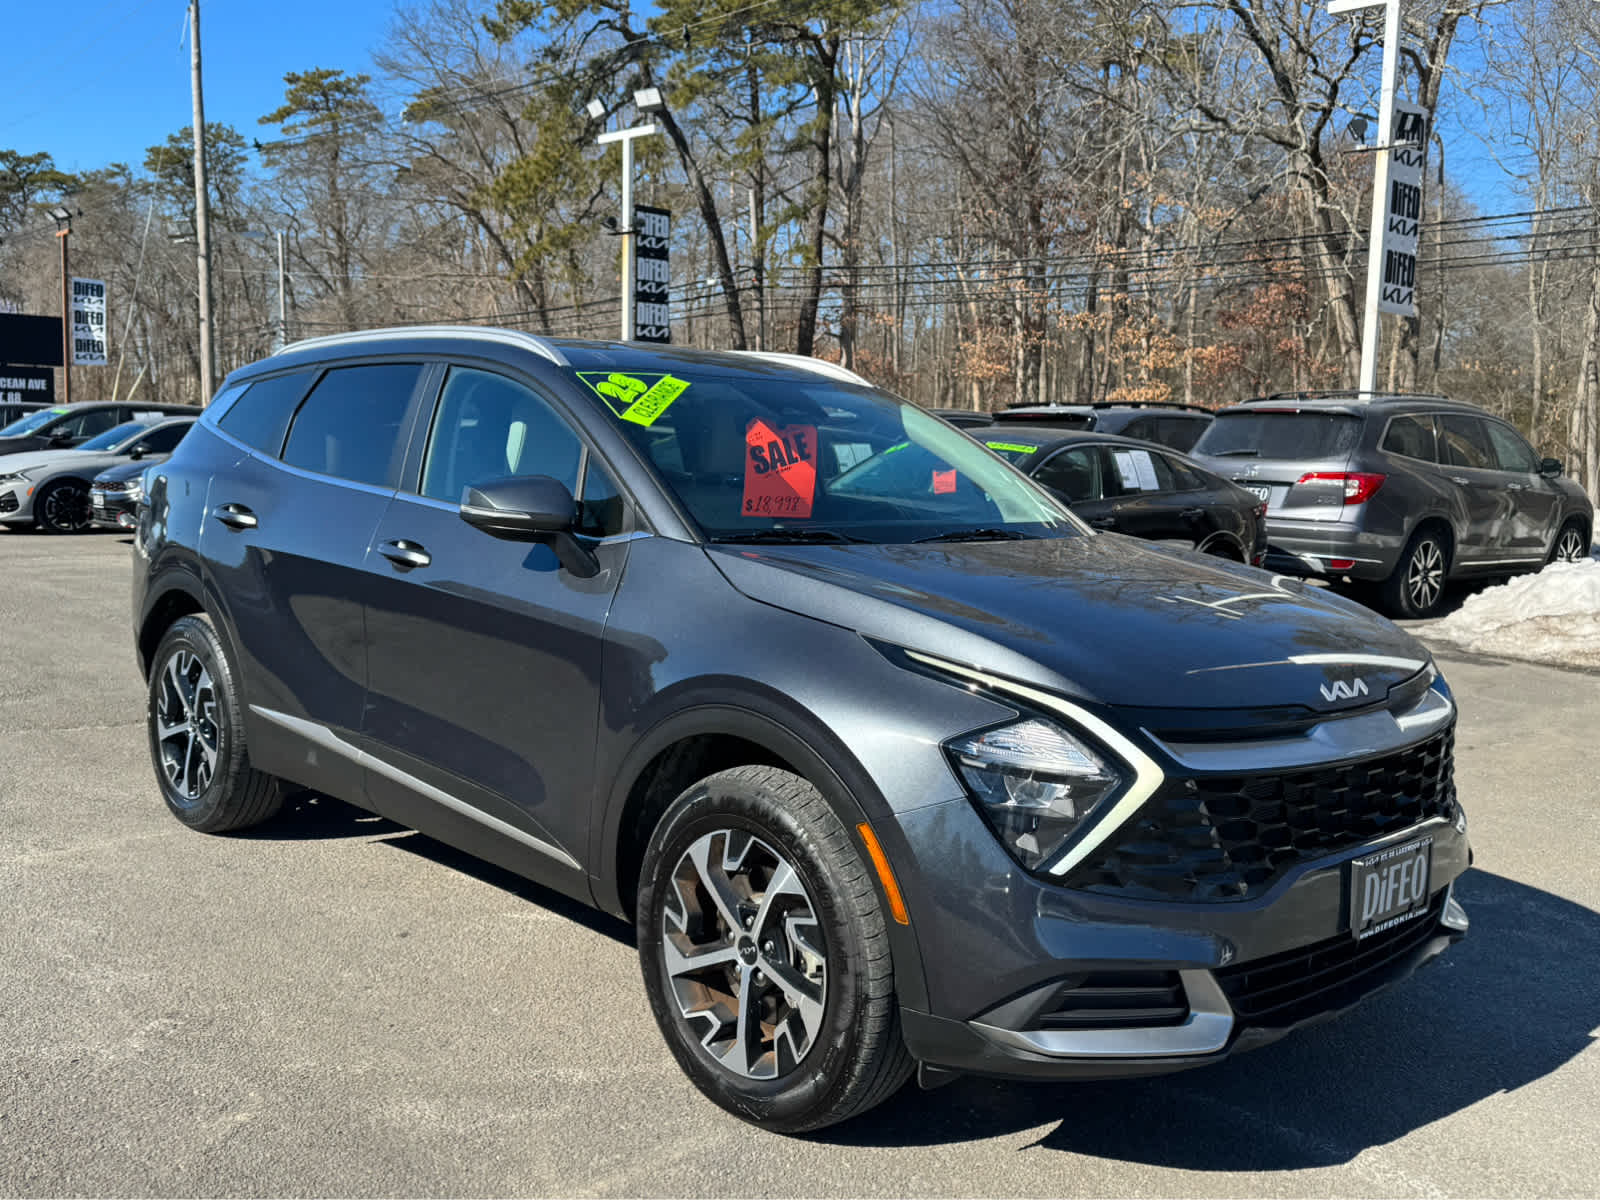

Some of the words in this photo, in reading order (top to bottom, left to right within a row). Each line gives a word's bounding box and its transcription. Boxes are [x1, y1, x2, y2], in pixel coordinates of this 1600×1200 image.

[1394, 149, 1423, 168] KIA
[1389, 217, 1418, 237] KIA
[637, 236, 669, 249] KIA
[637, 281, 669, 294] KIA
[1383, 286, 1413, 305] KIA
[637, 327, 669, 338] KIA
[0, 377, 26, 389] CEAN
[28, 379, 46, 390] AVE
[750, 432, 812, 475] SALE
[1320, 678, 1368, 701] KIA
[1361, 854, 1427, 921] DiFEO
